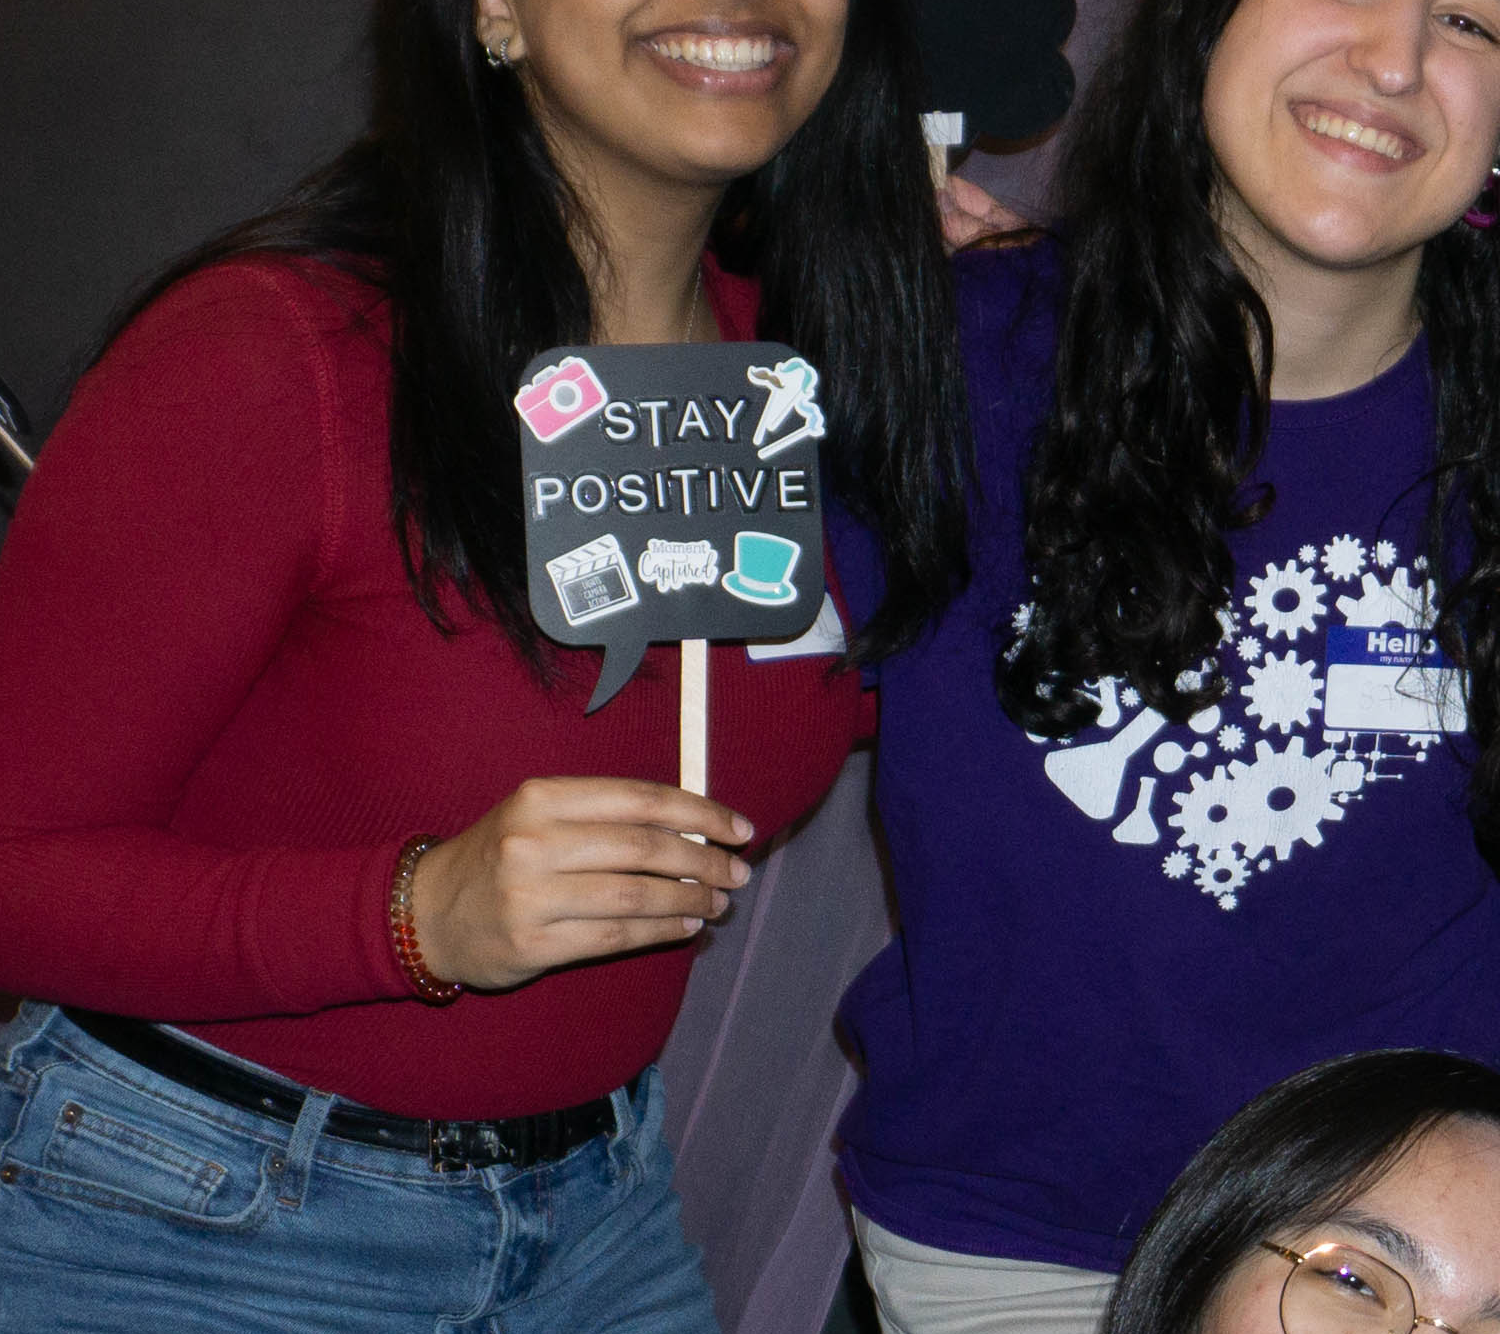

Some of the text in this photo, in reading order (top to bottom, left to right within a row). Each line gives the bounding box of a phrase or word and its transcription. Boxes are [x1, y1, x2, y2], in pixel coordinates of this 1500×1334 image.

[605, 399, 745, 447] STAY
[534, 469, 807, 515] POSITIVE
[651, 541, 707, 554] Moment
[642, 552, 714, 587] Captured
[1367, 631, 1437, 654] Hello
[1380, 656, 1392, 664] my
